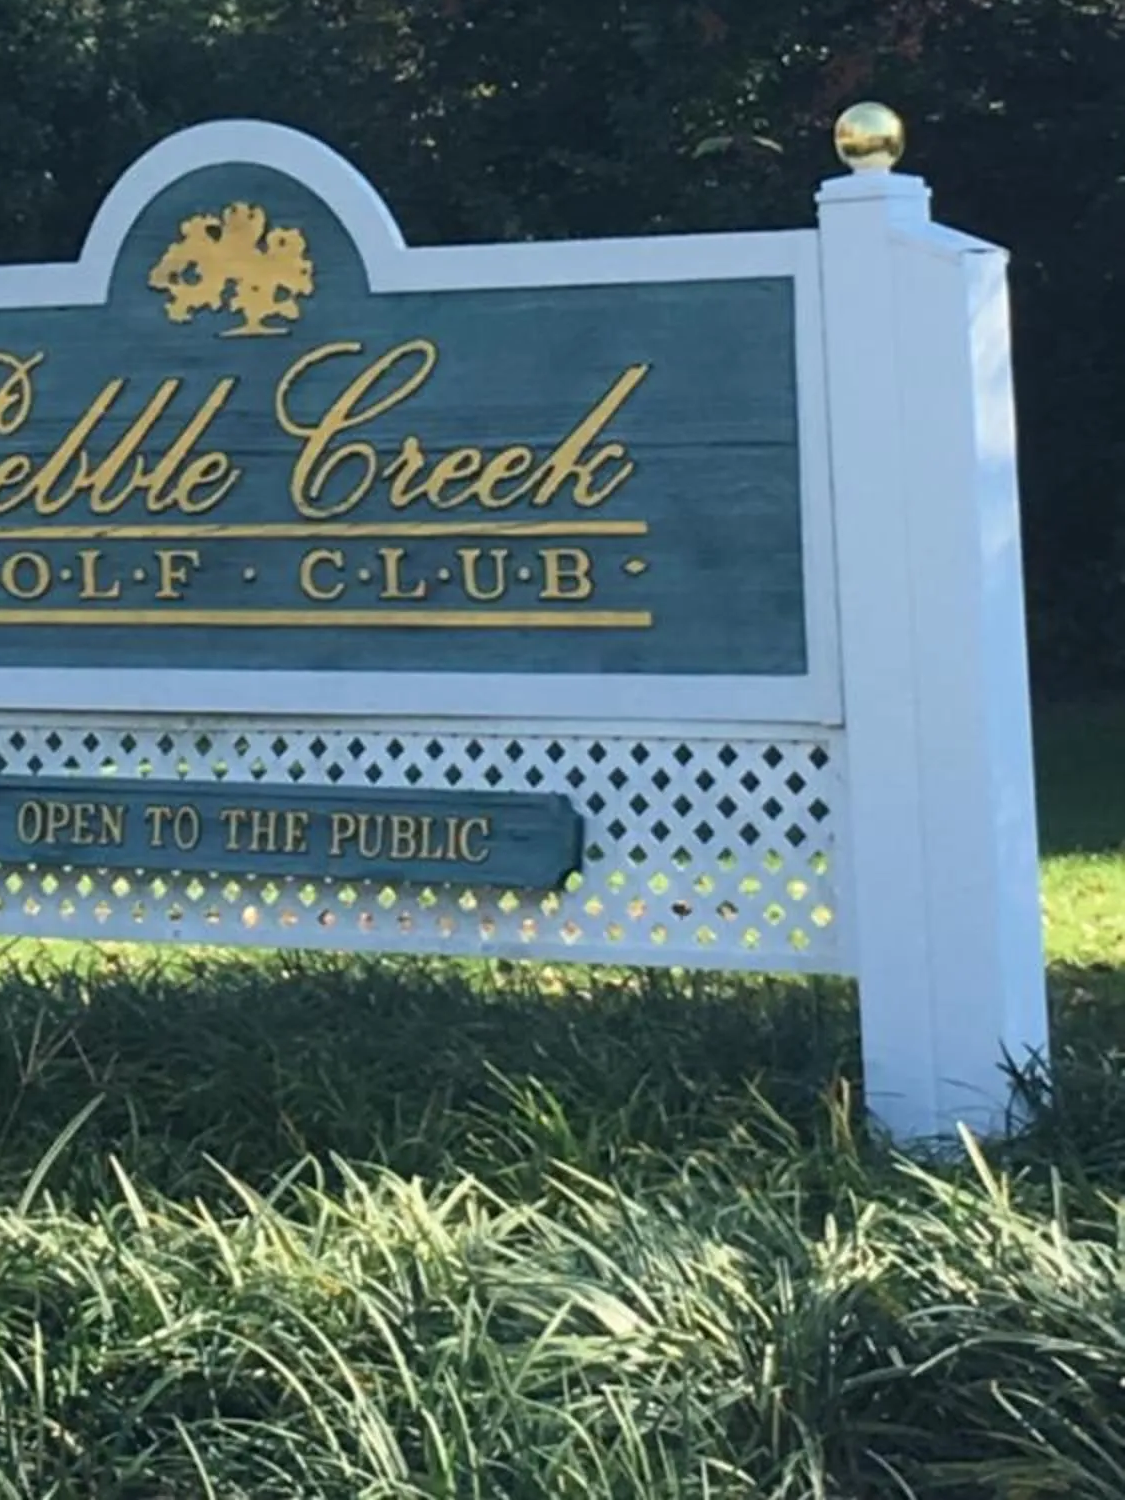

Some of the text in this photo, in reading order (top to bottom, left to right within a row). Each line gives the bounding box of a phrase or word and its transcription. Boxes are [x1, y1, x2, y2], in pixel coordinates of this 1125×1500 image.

[275, 340, 651, 519] Creek
[16, 800, 491, 863] OPEN TO THE PUBLIC
